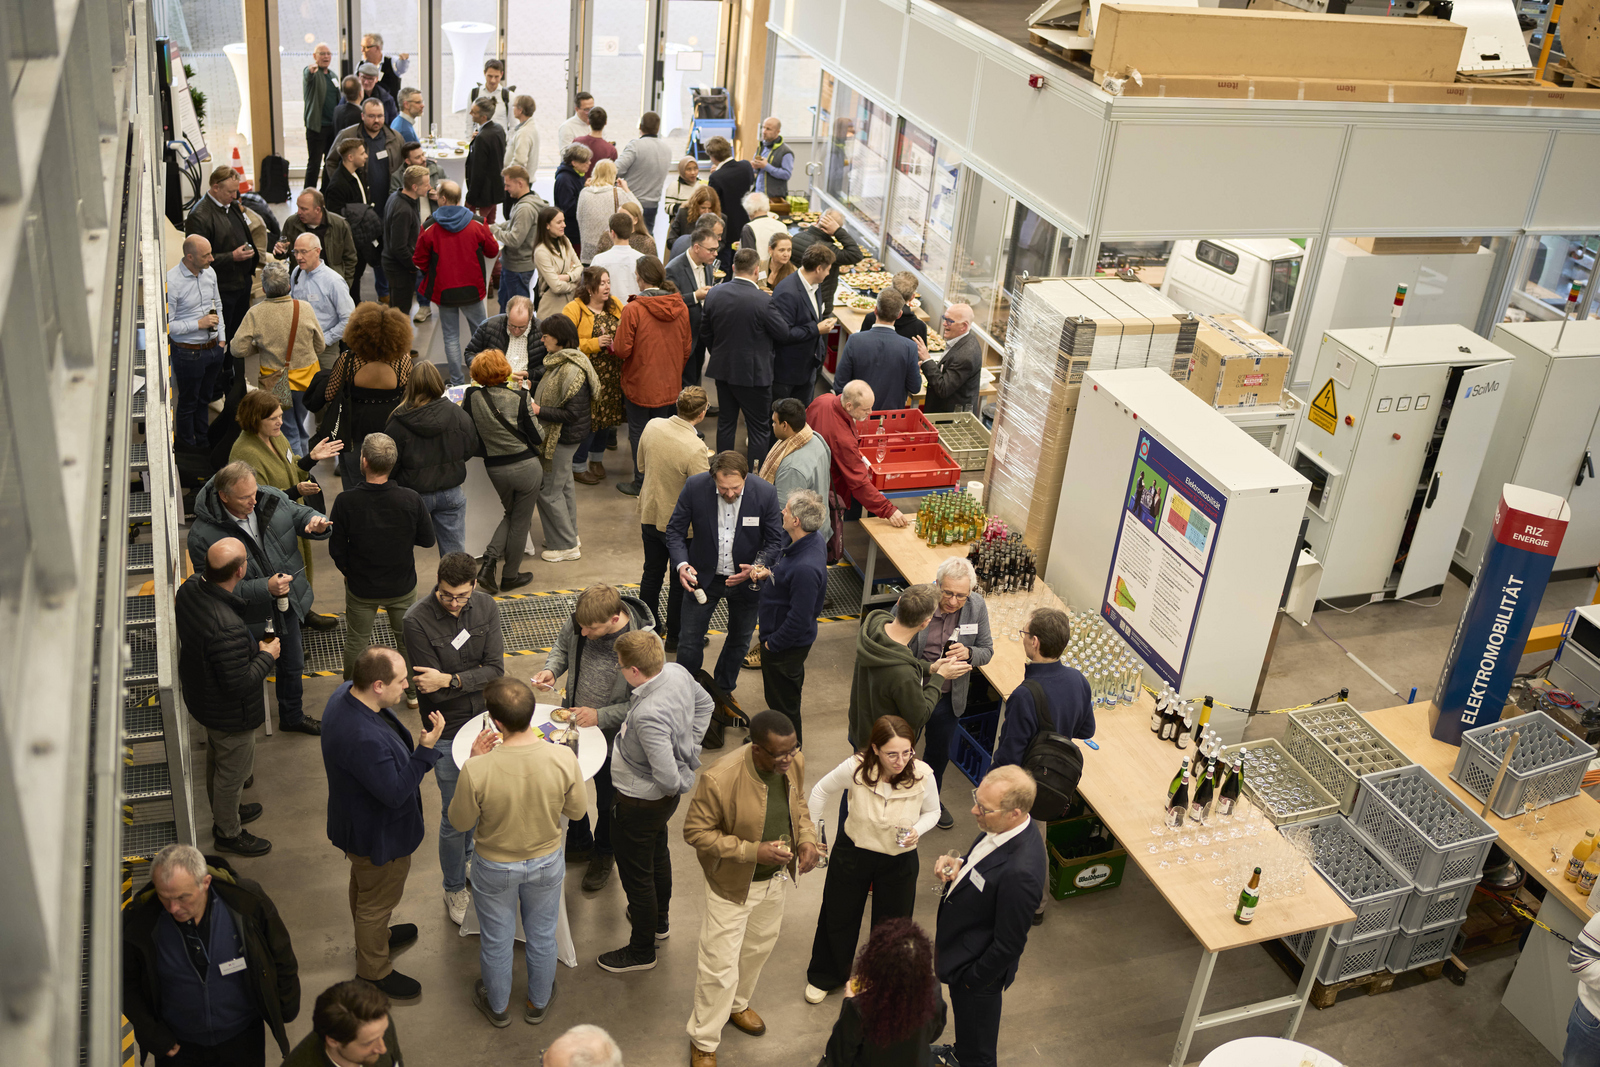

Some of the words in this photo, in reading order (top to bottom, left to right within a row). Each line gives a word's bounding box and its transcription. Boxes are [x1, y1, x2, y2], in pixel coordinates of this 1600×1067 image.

[1217, 81, 1239, 90] item
[1336, 85, 1356, 93] item
[1446, 88, 1464, 96] item
[1472, 380, 1500, 397] SciMo
[1185, 476, 1221, 510] Elektromobilität
[1525, 525, 1544, 537] RIZ
[1512, 532, 1550, 548] ENERGIE
[1461, 574, 1524, 725] ELEKTROMOBILITÄT
[1078, 872, 1107, 883] Waldhaus
